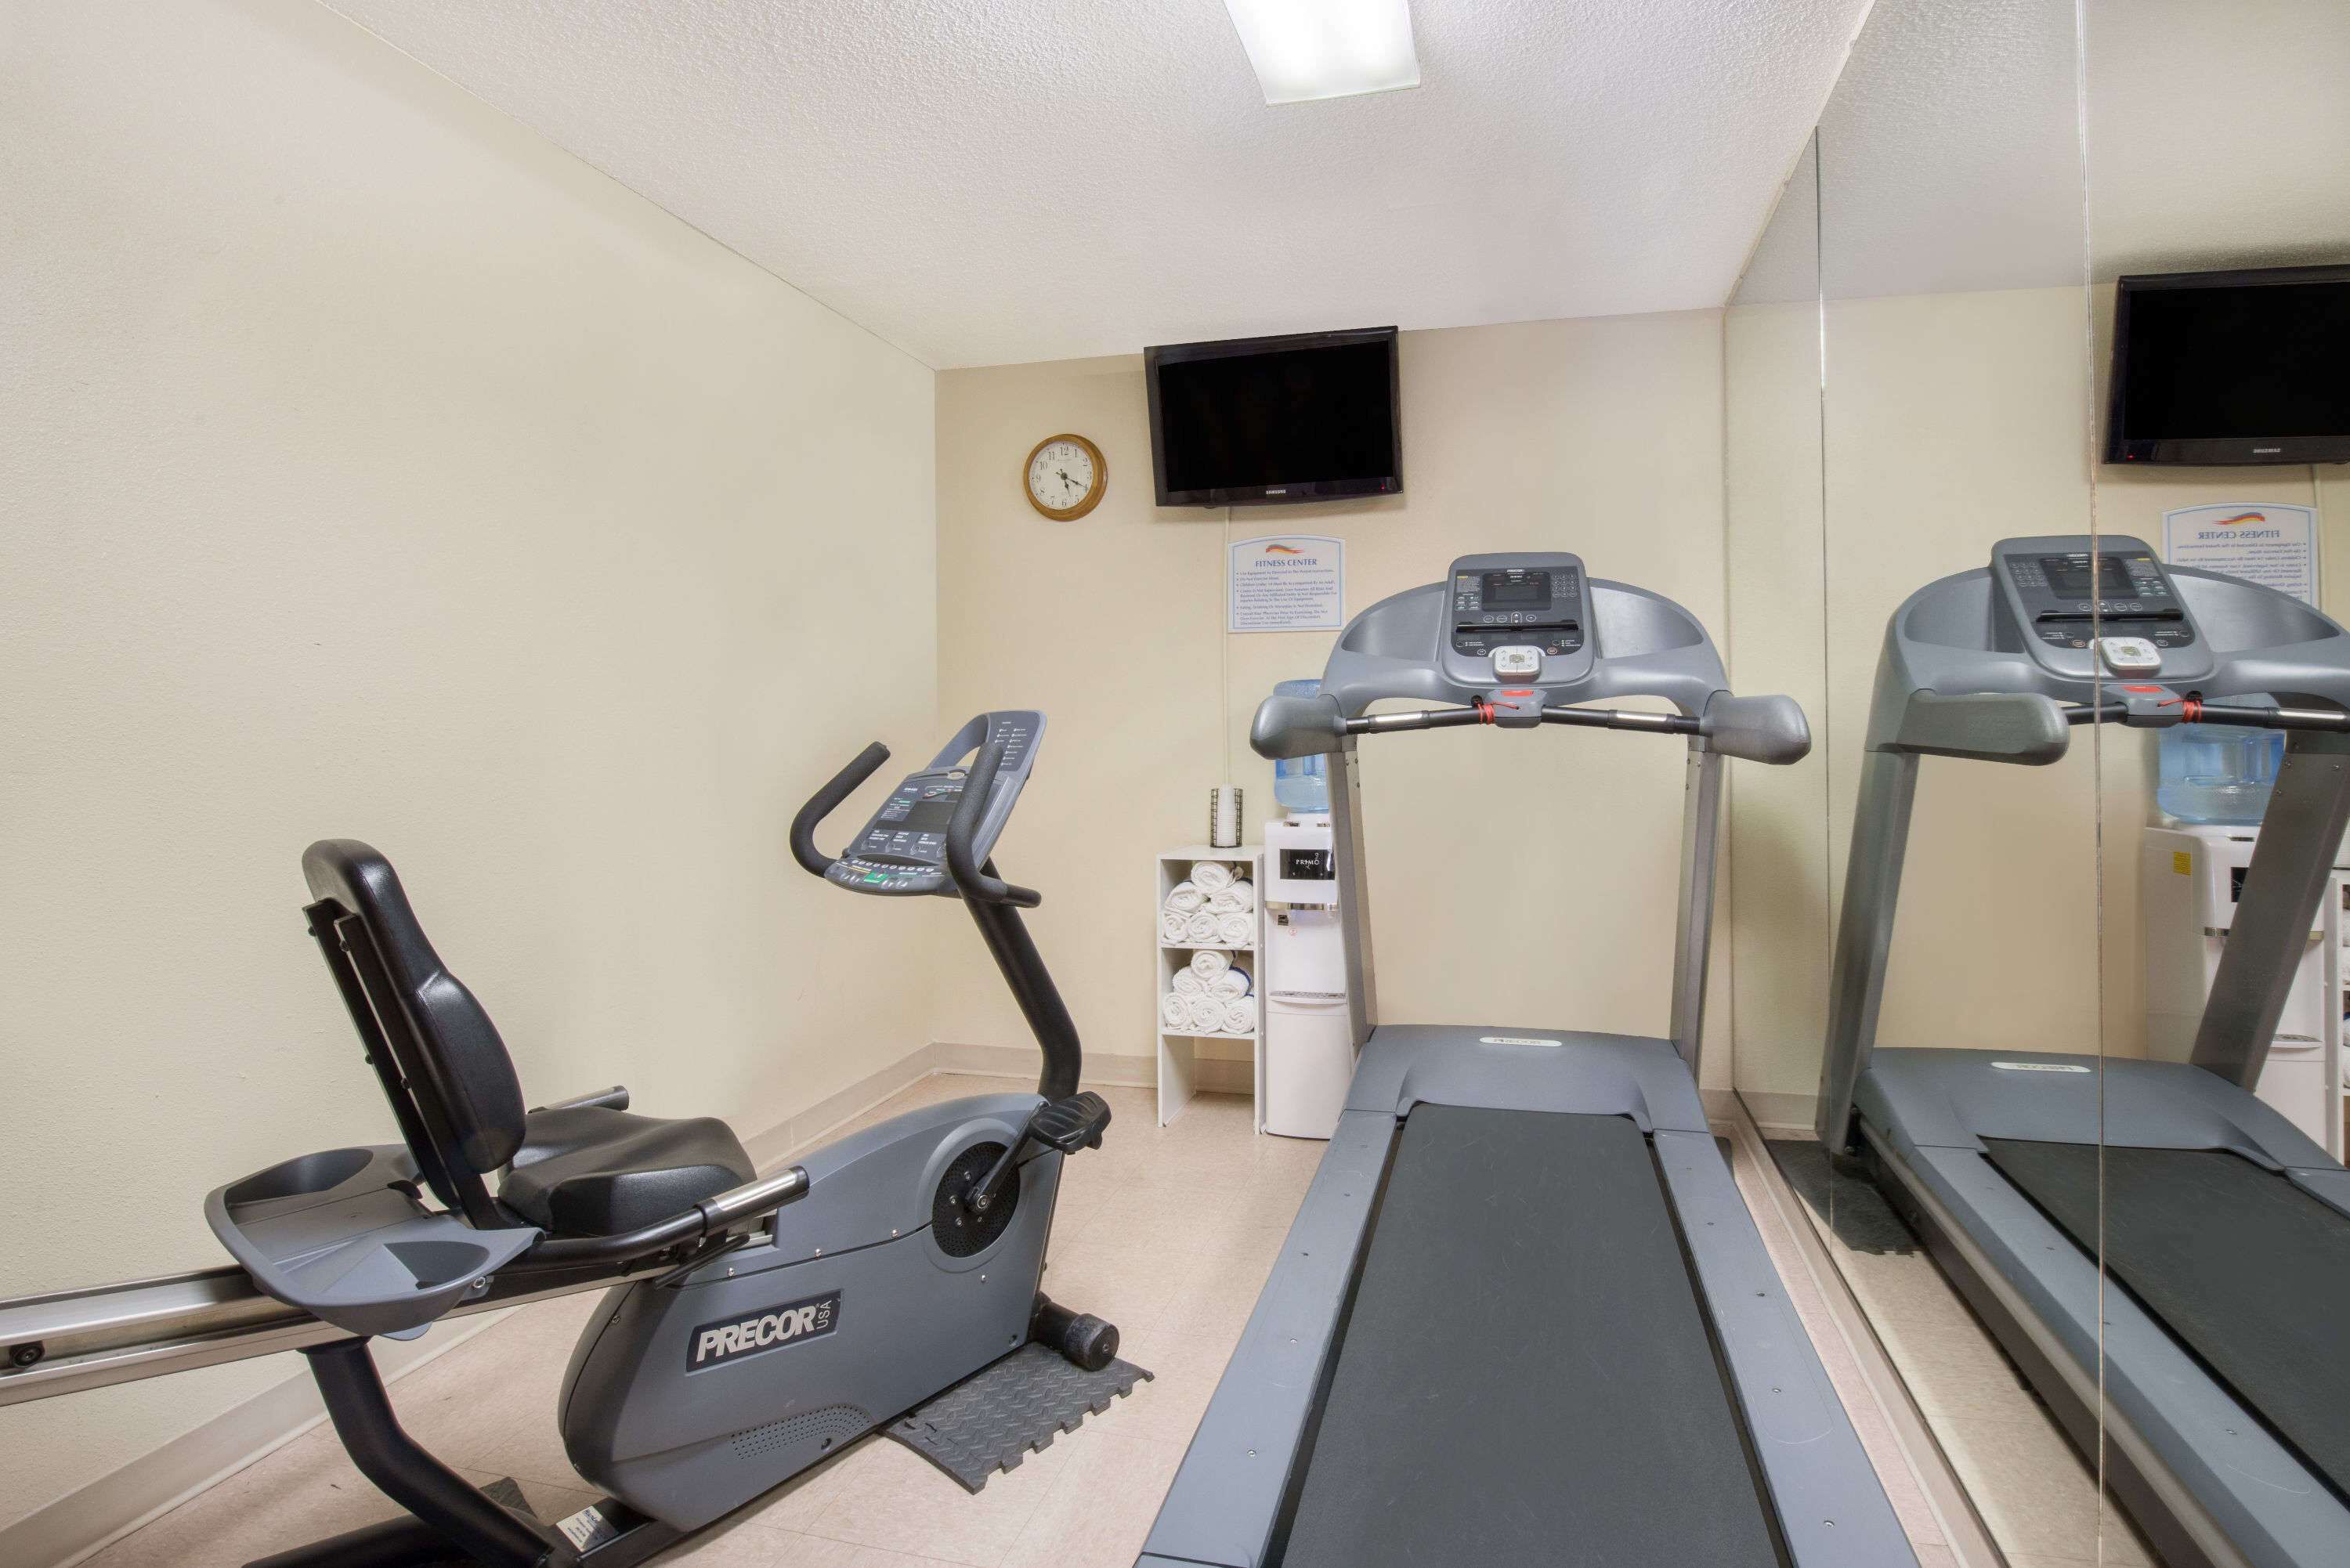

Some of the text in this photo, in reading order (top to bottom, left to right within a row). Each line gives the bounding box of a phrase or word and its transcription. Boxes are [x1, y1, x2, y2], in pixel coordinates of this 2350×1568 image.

[1048, 451, 1055, 461] 11
[1060, 446, 1070, 456] 12
[1040, 461, 1048, 470] 10
[696, 1299, 832, 1362] PRECOR USA
